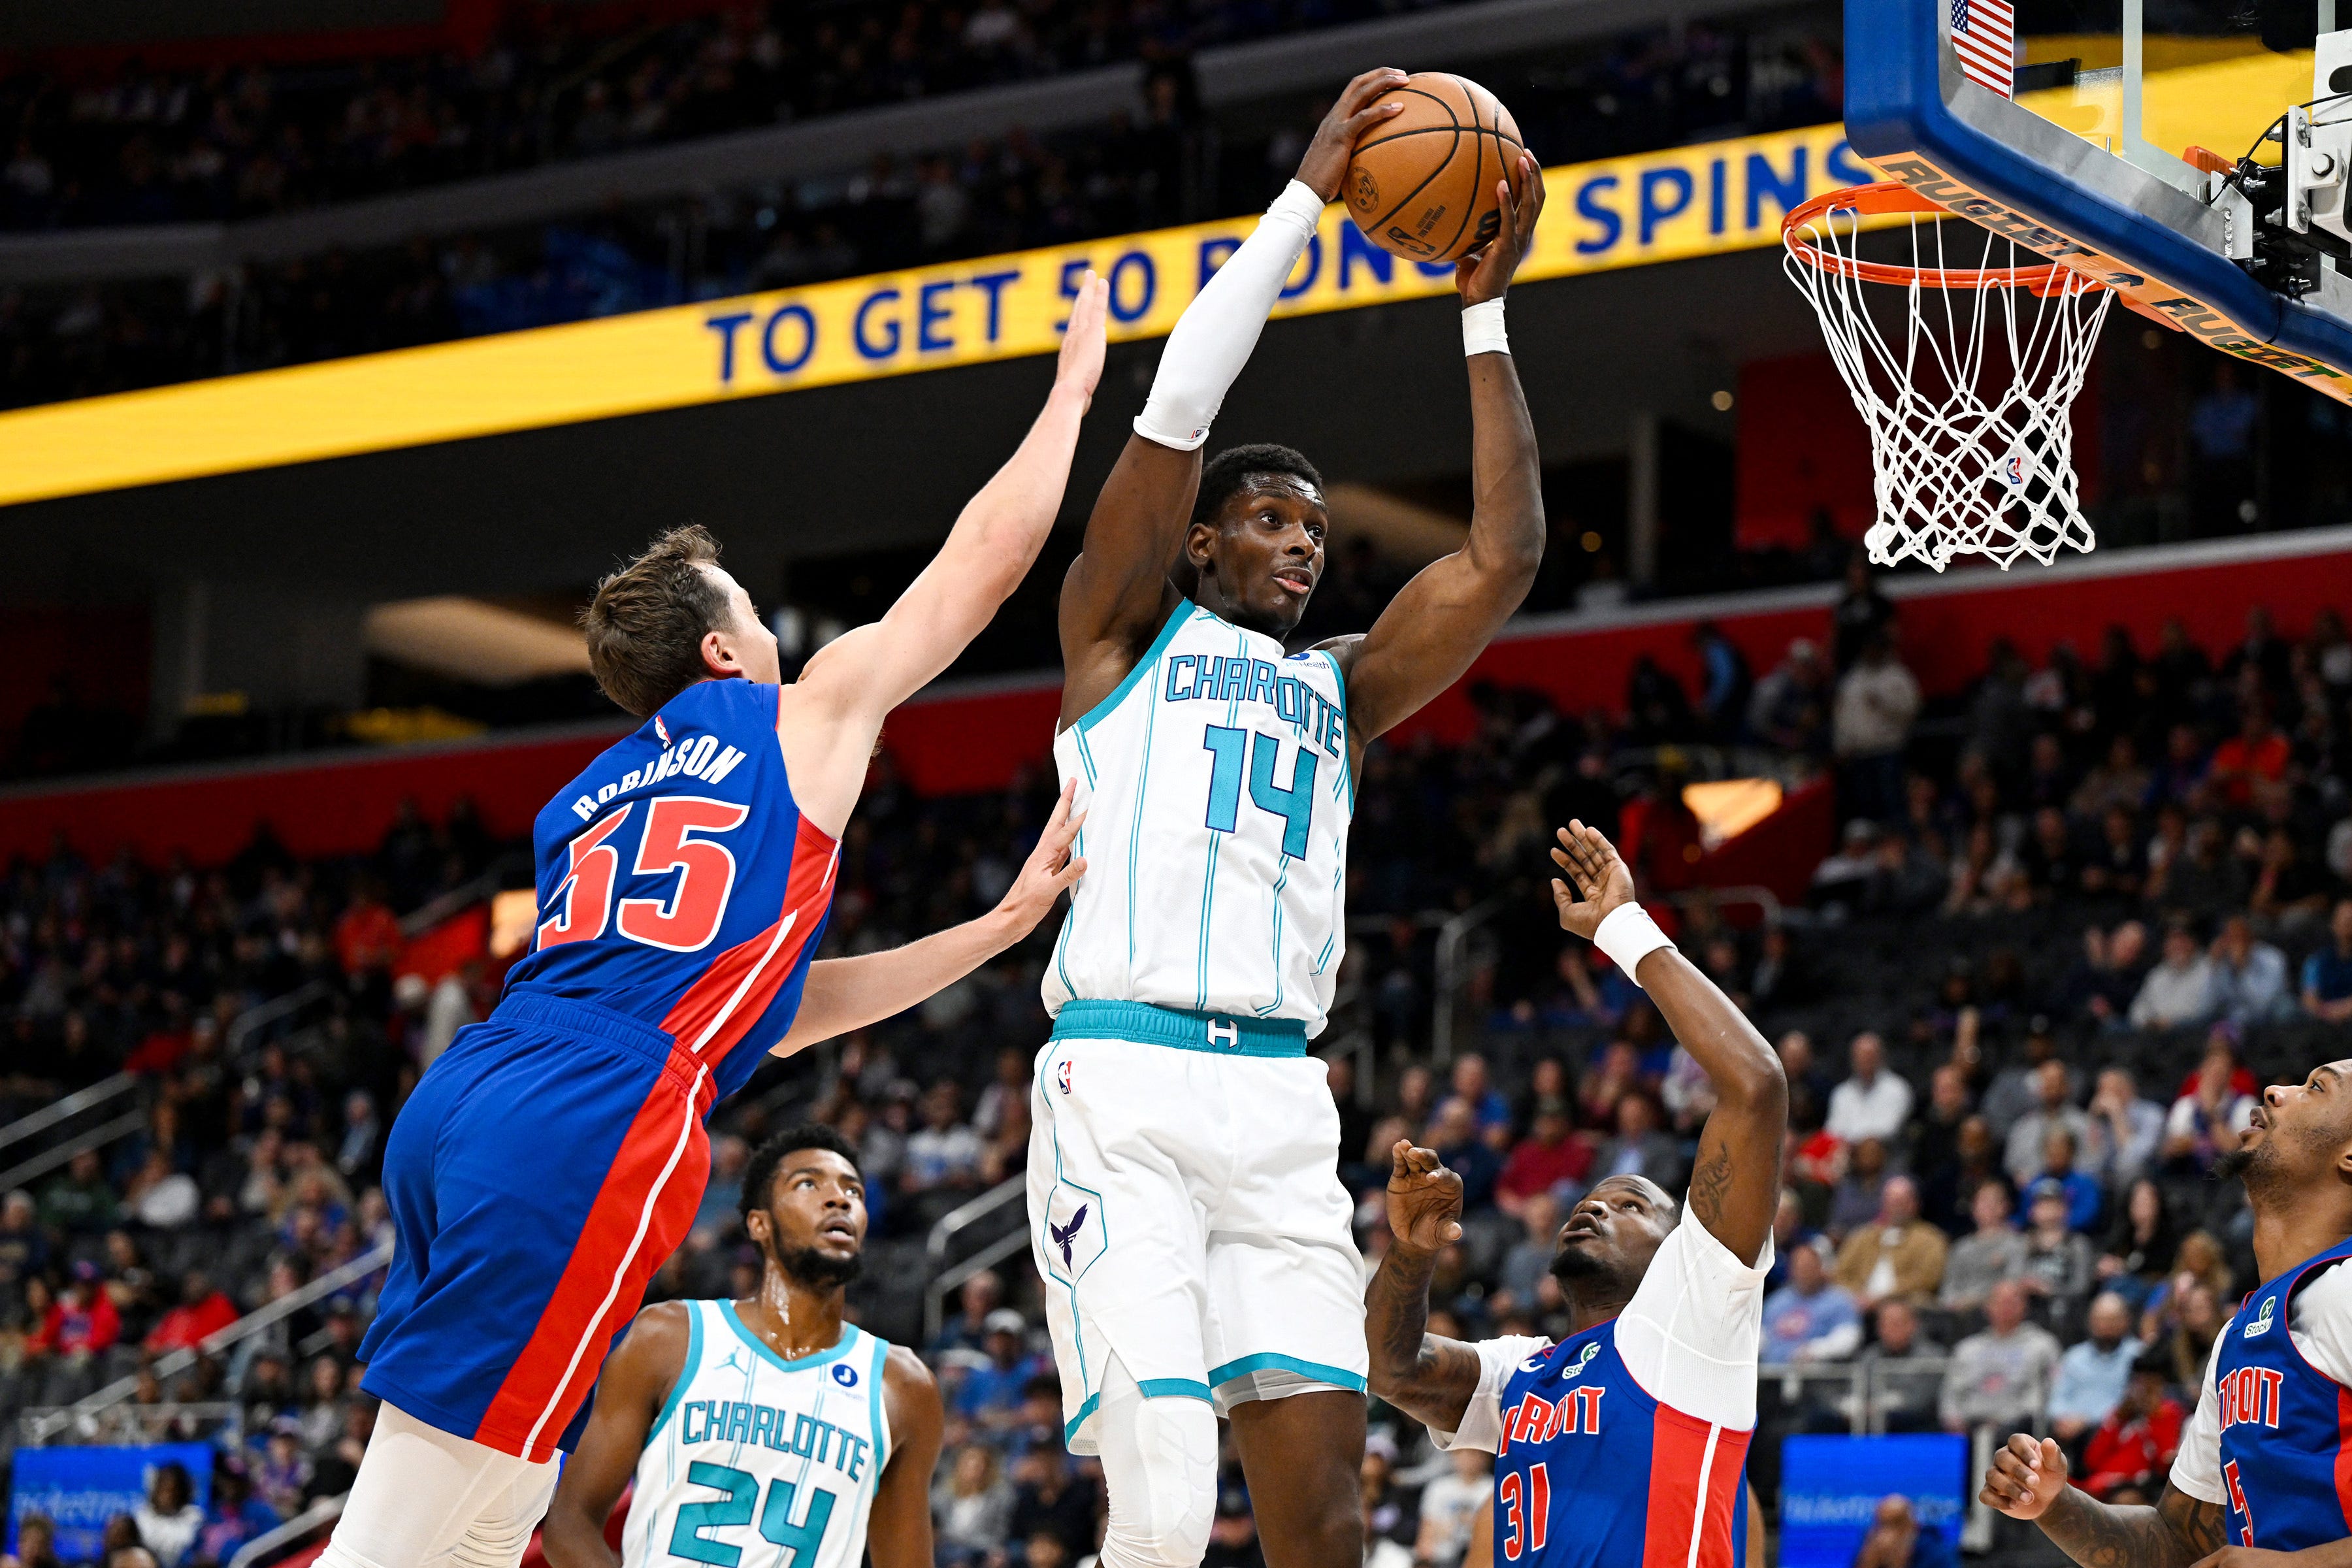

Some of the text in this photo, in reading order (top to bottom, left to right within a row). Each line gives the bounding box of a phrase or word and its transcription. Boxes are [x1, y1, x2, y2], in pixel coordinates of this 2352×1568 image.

[706, 304, 816, 382] TO
[853, 270, 1021, 359] GET
[1054, 252, 1155, 333] 50
[1575, 139, 1874, 255] SPINS
[1880, 159, 2343, 378] RUGIET RUGIET
[1165, 655, 1343, 759] CHAROTTE
[571, 735, 747, 821] ROBINSON
[1203, 723, 1319, 861] 14
[537, 796, 750, 952] 55
[683, 1400, 868, 1483] CHARLOTTE
[668, 1461, 836, 1568] 24
[1501, 1462, 1550, 1561] 31
[2223, 1458, 2253, 1547] 5
